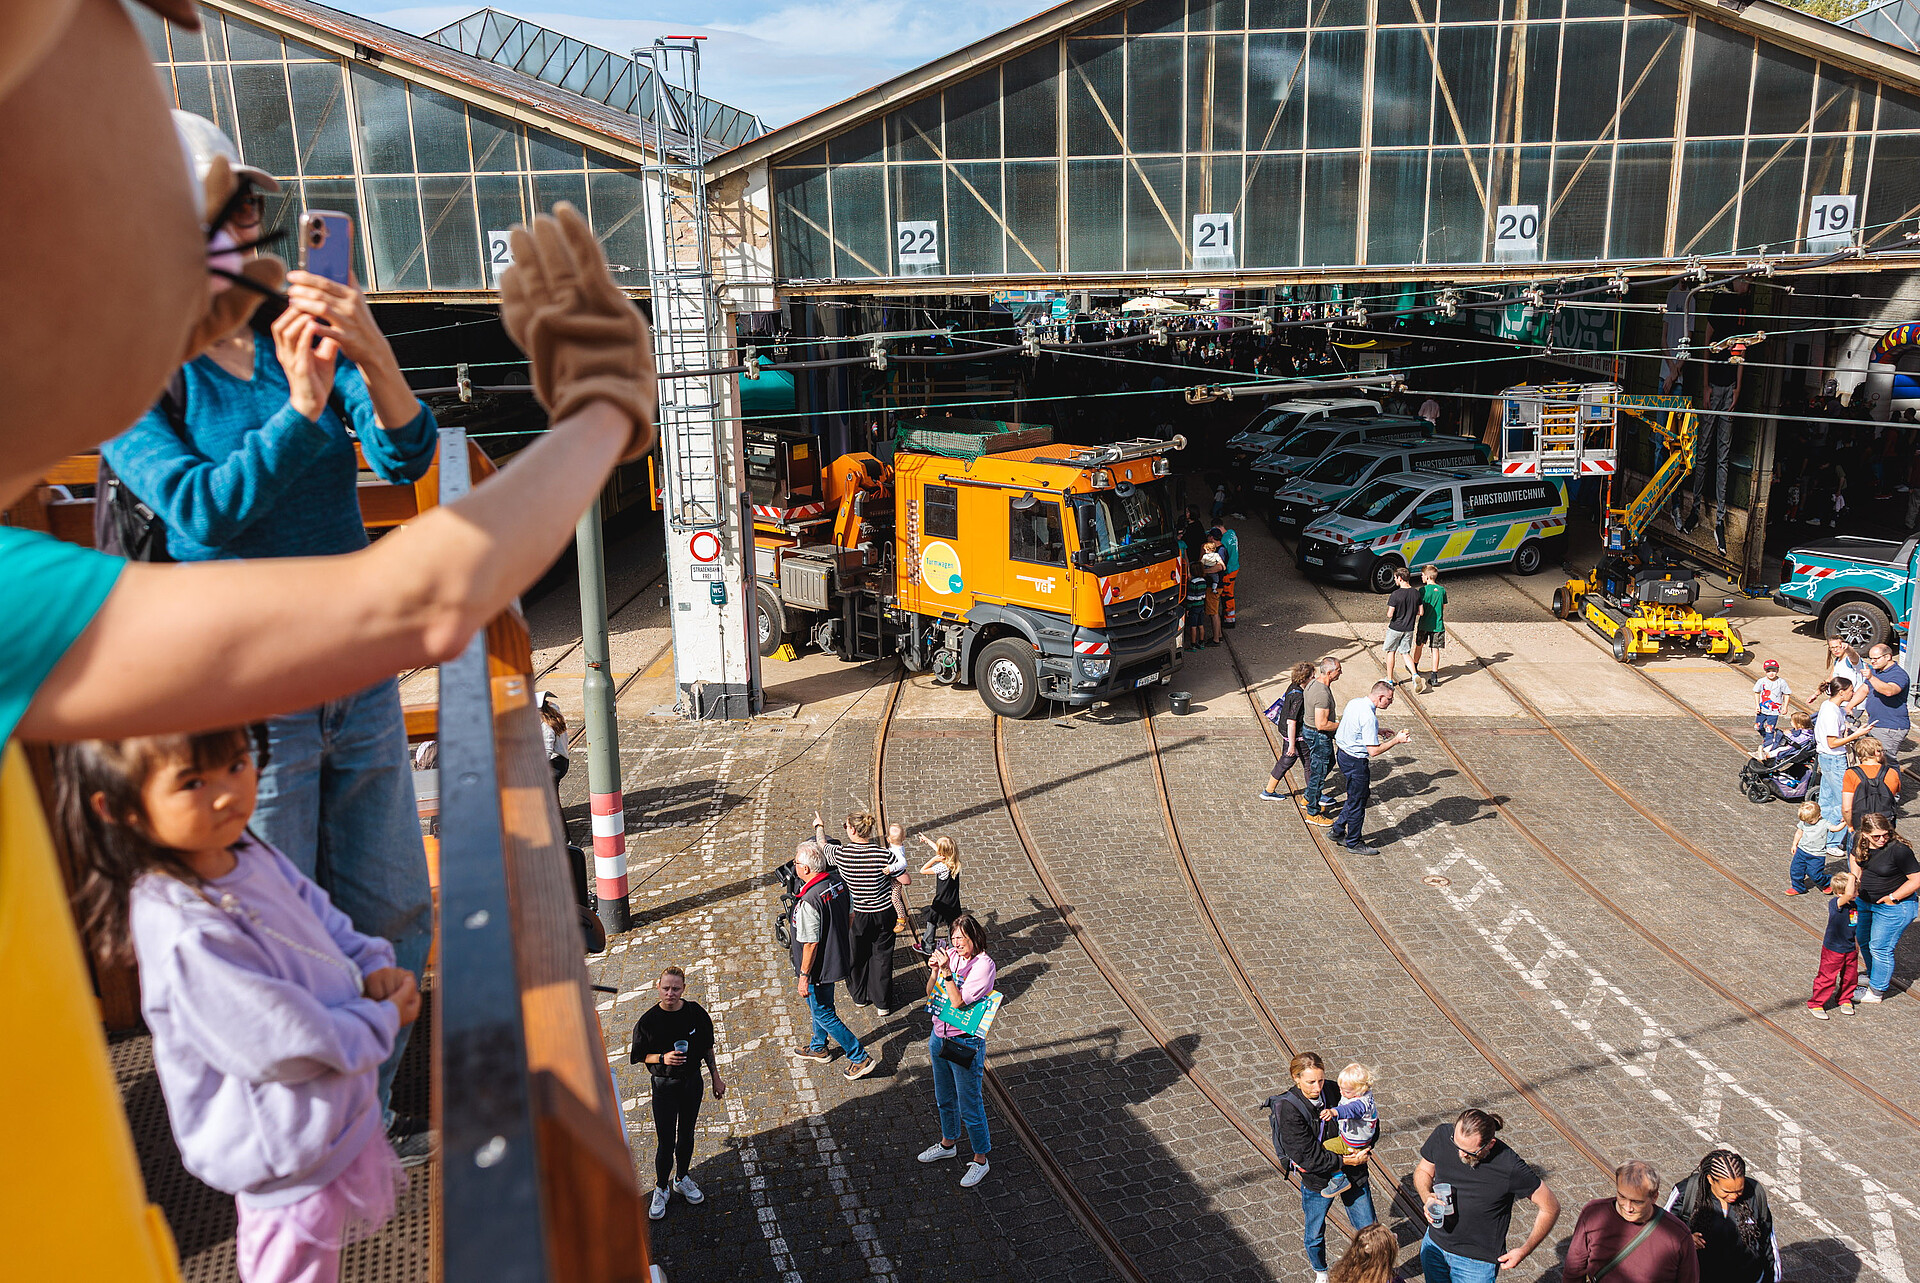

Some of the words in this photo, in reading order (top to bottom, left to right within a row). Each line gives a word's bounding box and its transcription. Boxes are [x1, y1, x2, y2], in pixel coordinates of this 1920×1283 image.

[1499, 214, 1538, 240] 20
[1814, 204, 1849, 231] 19
[899, 229, 936, 254] 22
[1198, 221, 1230, 247] 21
[492, 239, 515, 264] 2
[1469, 487, 1546, 507] FAHRSTROMTECHNIK
[1035, 576, 1056, 594] VGF
